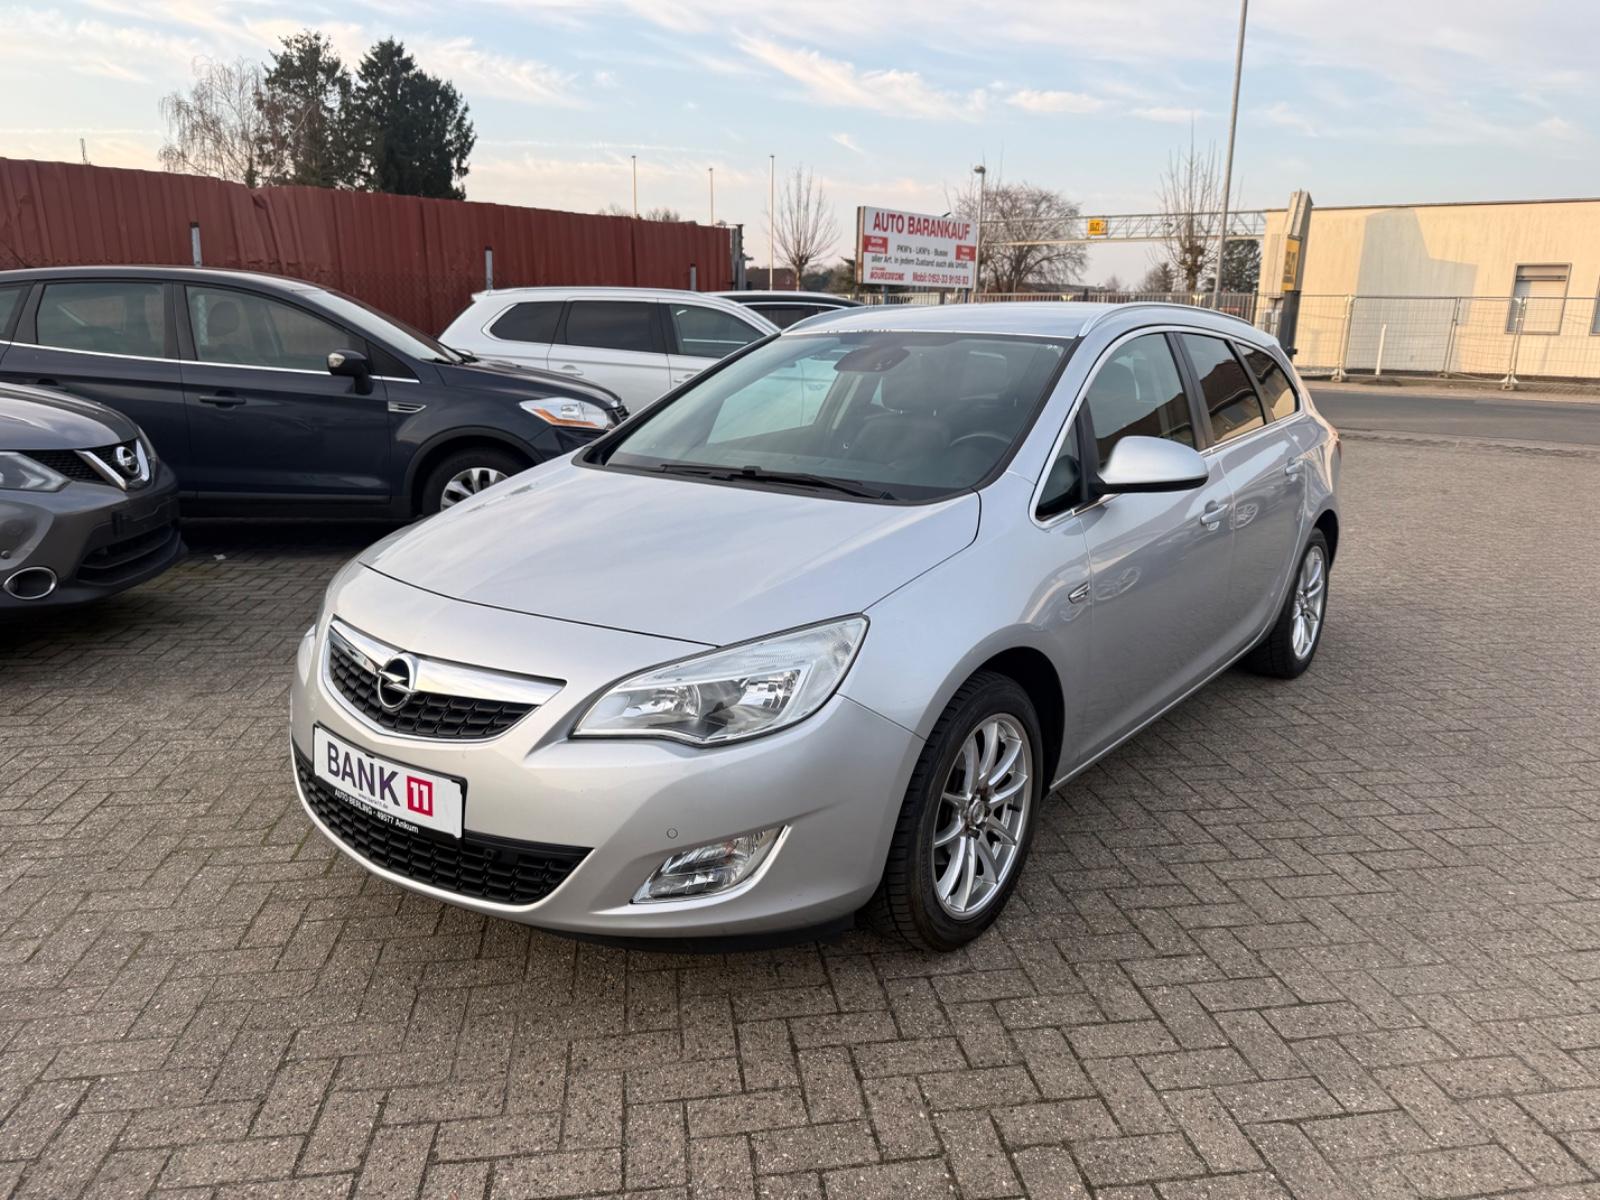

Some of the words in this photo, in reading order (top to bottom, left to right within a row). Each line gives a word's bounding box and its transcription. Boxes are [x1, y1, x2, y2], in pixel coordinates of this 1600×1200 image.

[873, 212, 904, 234] AUTO
[907, 215, 971, 241] BARANKAUF
[327, 741, 401, 807] BANK
[409, 779, 430, 813] 11
[334, 789, 349, 802] AUTO
[395, 818, 419, 835] Ankum
